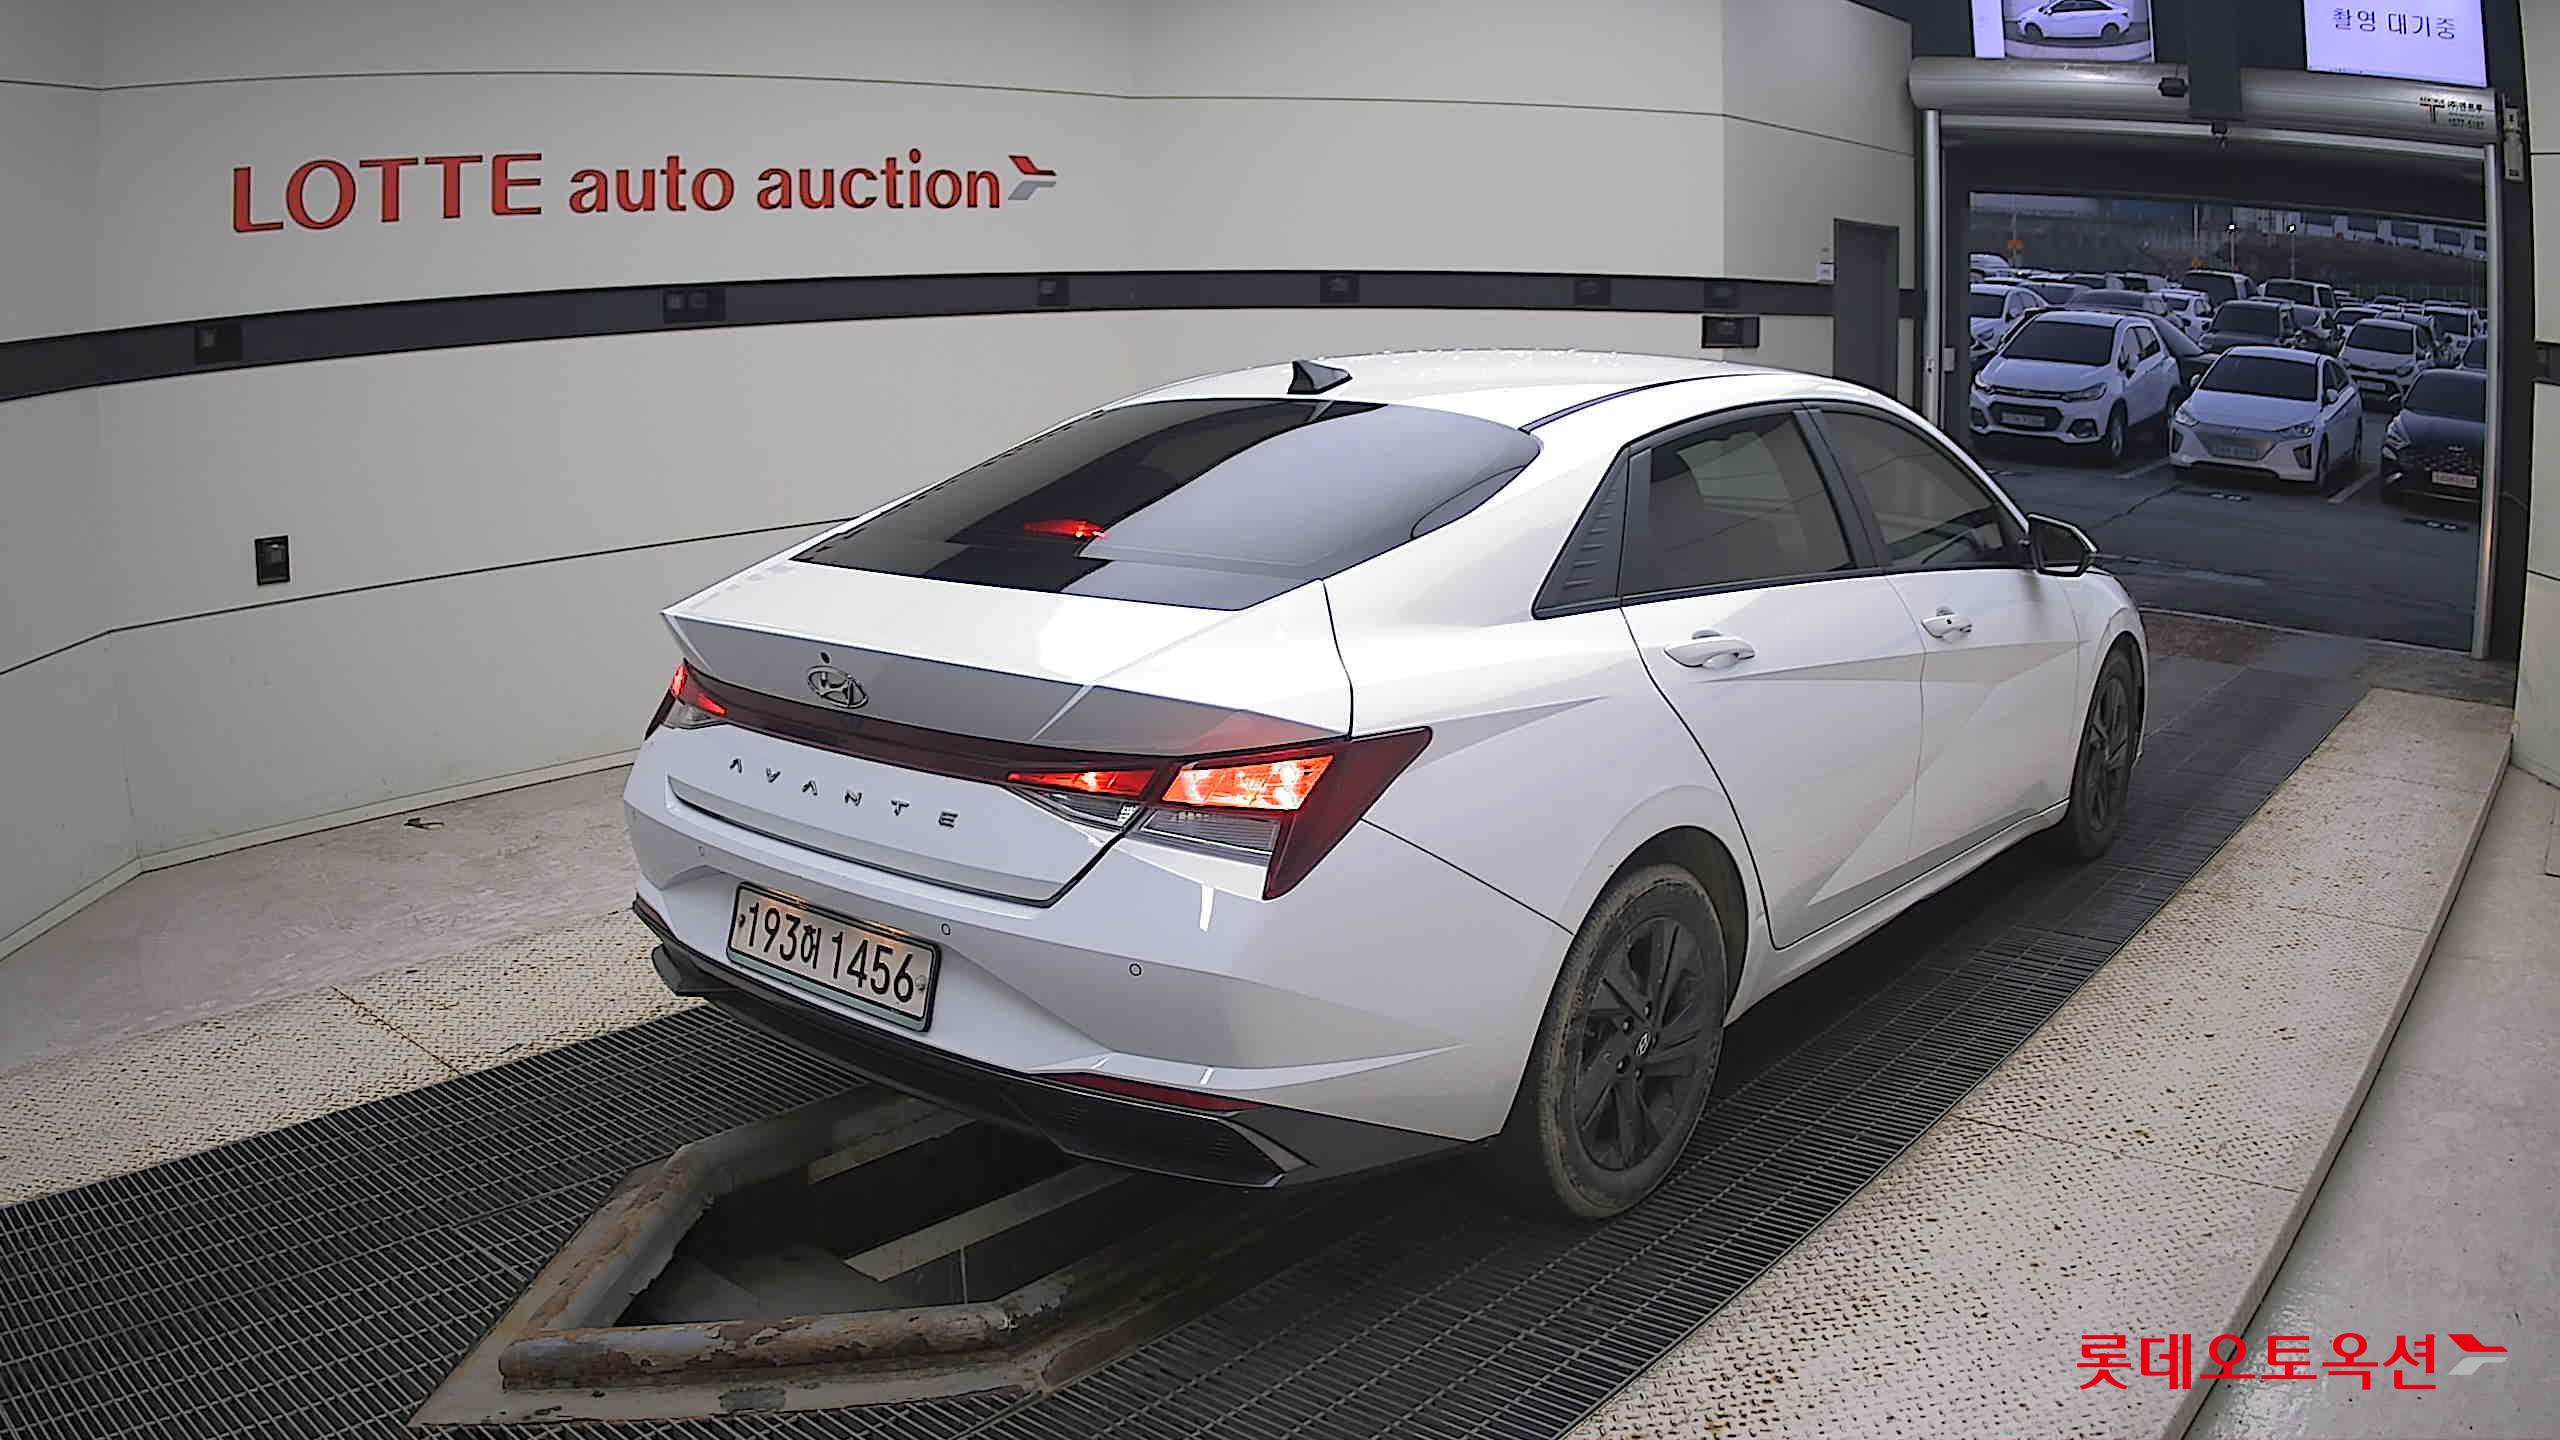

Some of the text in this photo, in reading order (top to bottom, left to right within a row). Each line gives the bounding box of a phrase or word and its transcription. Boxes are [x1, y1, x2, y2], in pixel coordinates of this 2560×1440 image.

[2333, 8, 2456, 40] 촬영 대기중
[232, 148, 1001, 233] LOTTE auto auction
[729, 757, 959, 829] AVANTE
